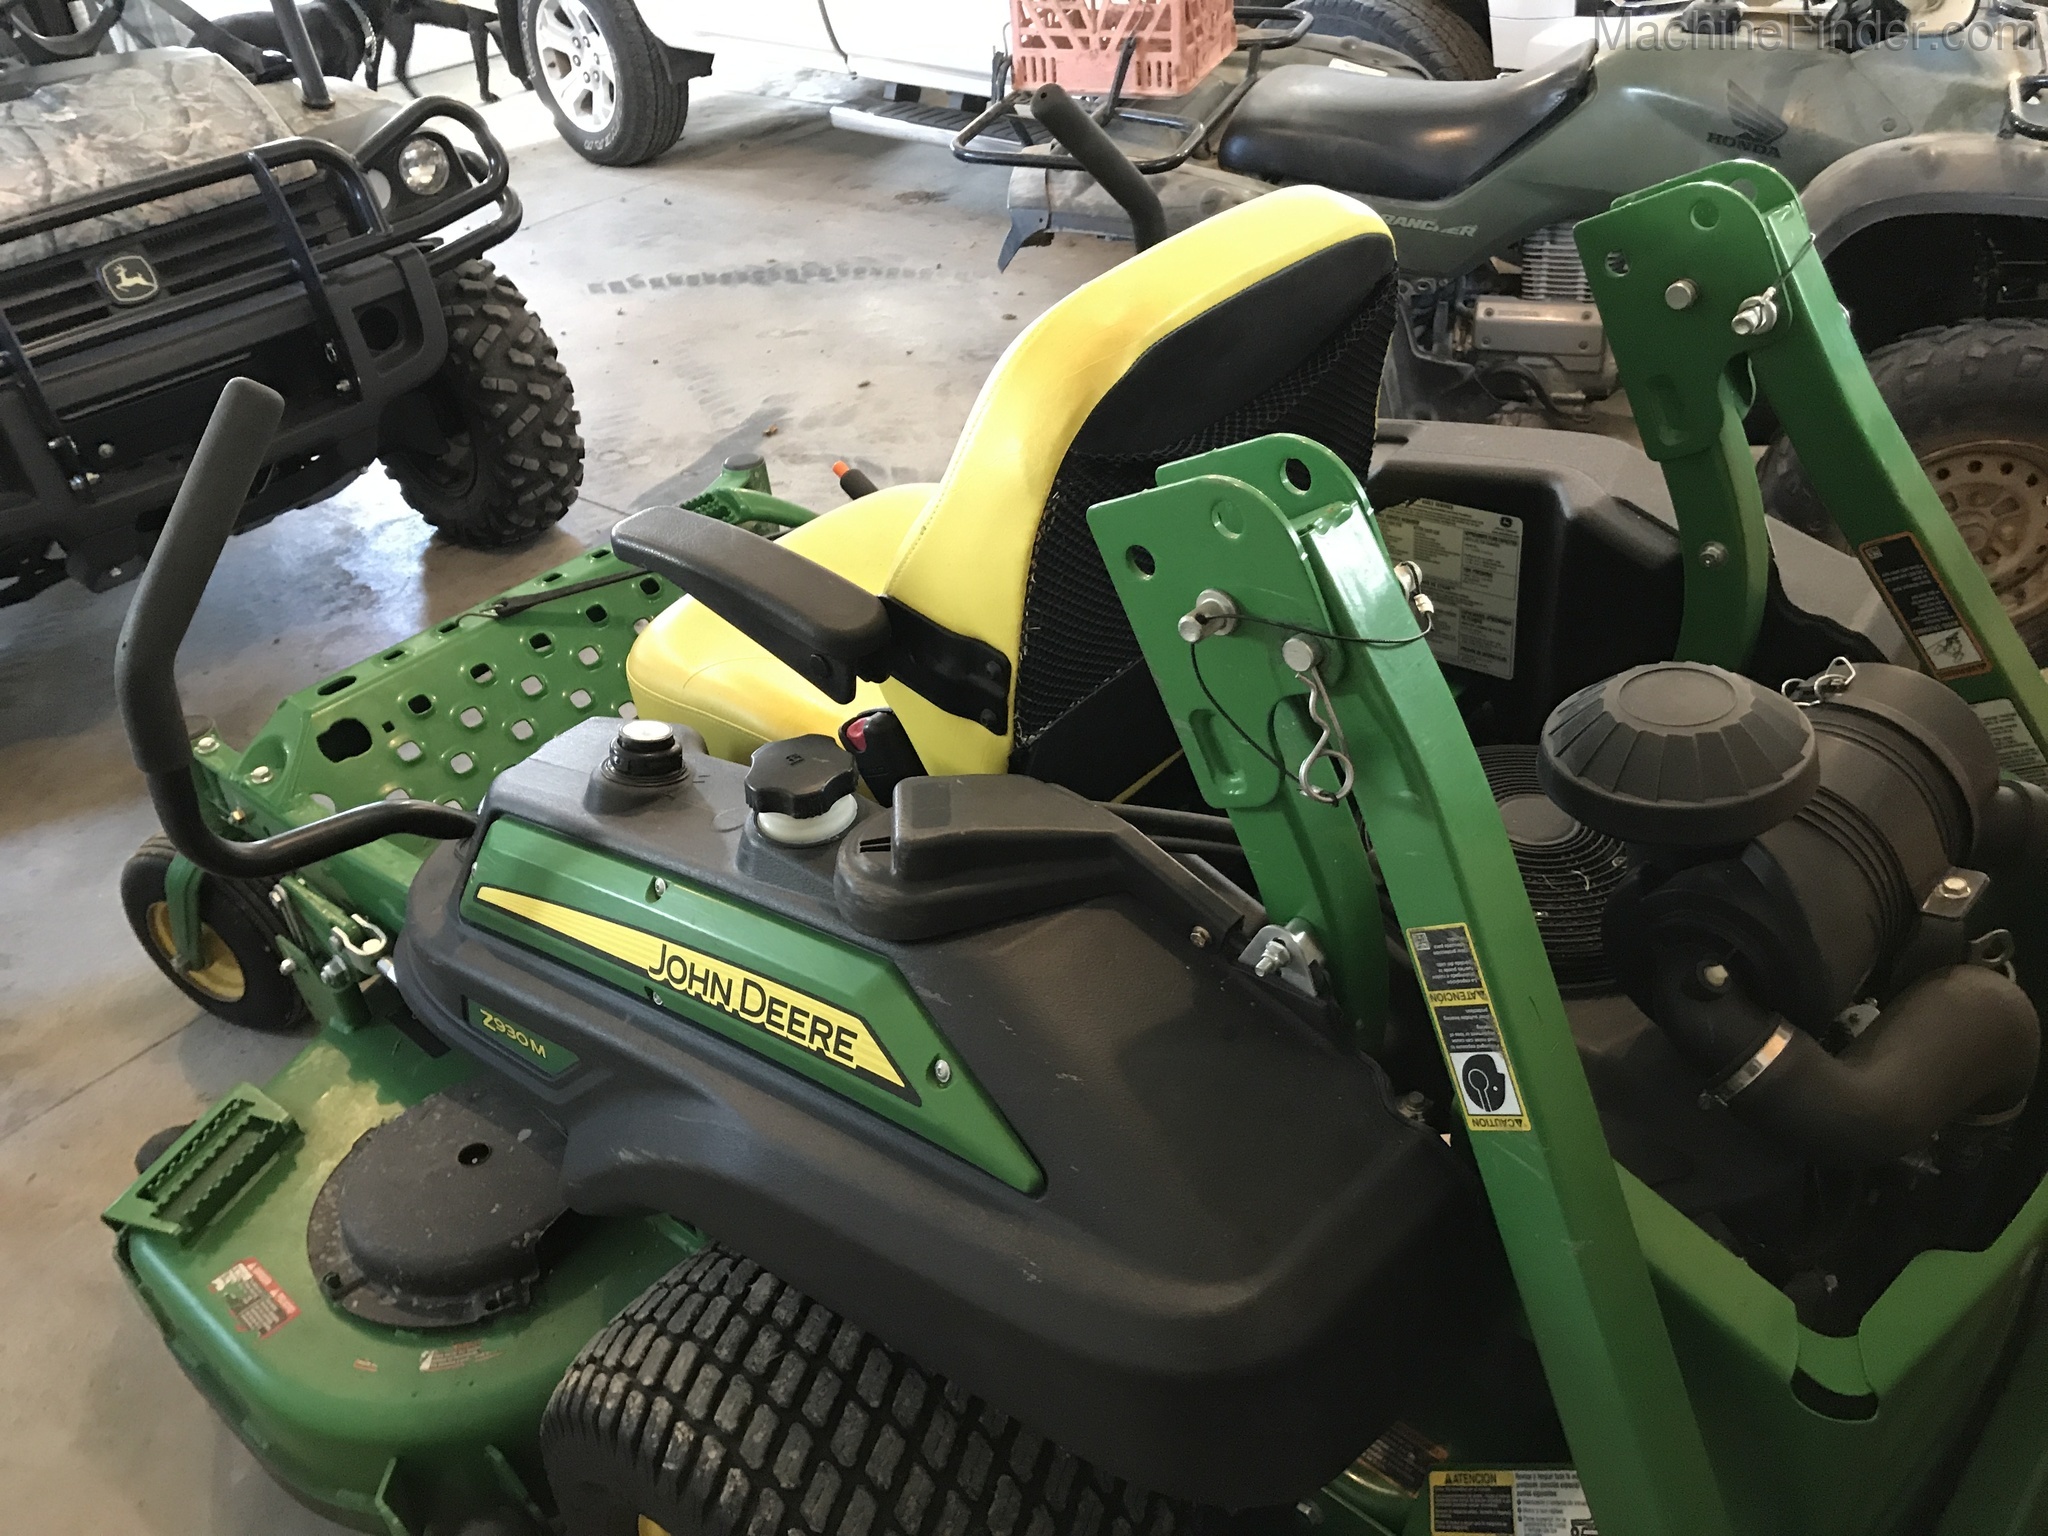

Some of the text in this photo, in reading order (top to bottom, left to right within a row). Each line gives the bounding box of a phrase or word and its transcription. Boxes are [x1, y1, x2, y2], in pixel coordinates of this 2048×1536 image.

[1706, 132, 1782, 158] HONDA
[649, 943, 858, 1062] JOHN DEERE
[1429, 990, 1478, 1004] ATENCIÓN
[480, 1008, 547, 1059] Z930M
[1471, 1118, 1515, 1128] CAUTION
